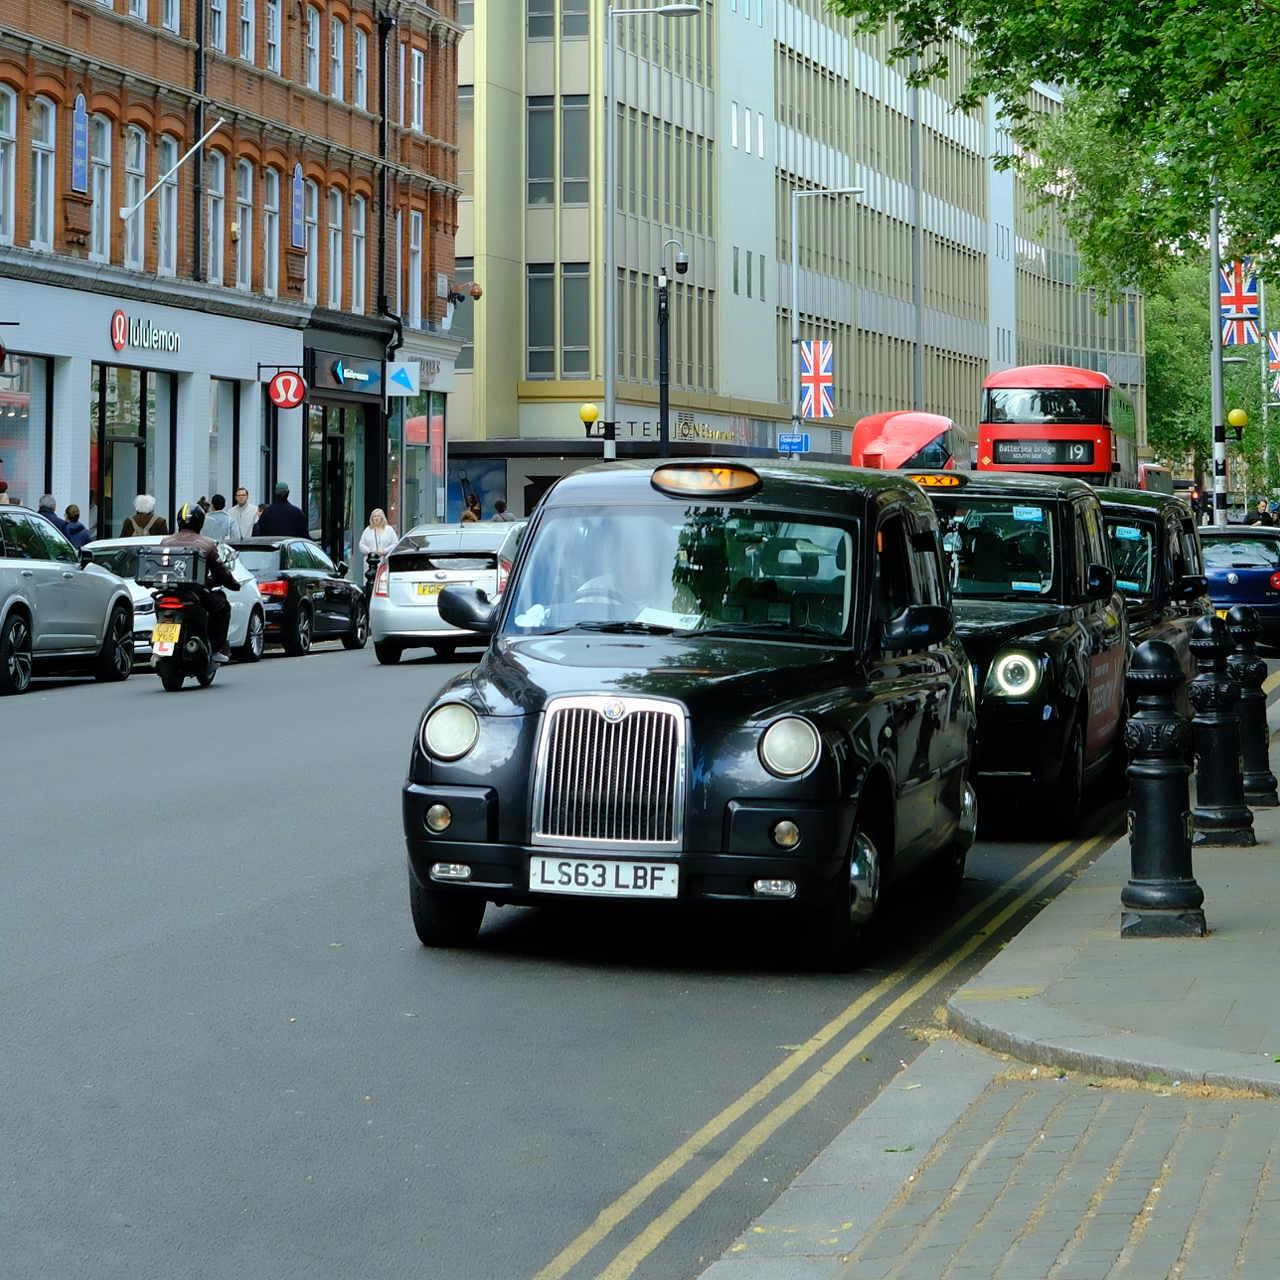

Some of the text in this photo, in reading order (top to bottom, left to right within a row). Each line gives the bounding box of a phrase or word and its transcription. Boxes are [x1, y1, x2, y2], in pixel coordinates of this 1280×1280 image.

[128, 316, 181, 352] lululemon
[1069, 444, 1084, 460] 19
[917, 475, 954, 485] AXI
[540, 860, 666, 891] LS63 LBF
